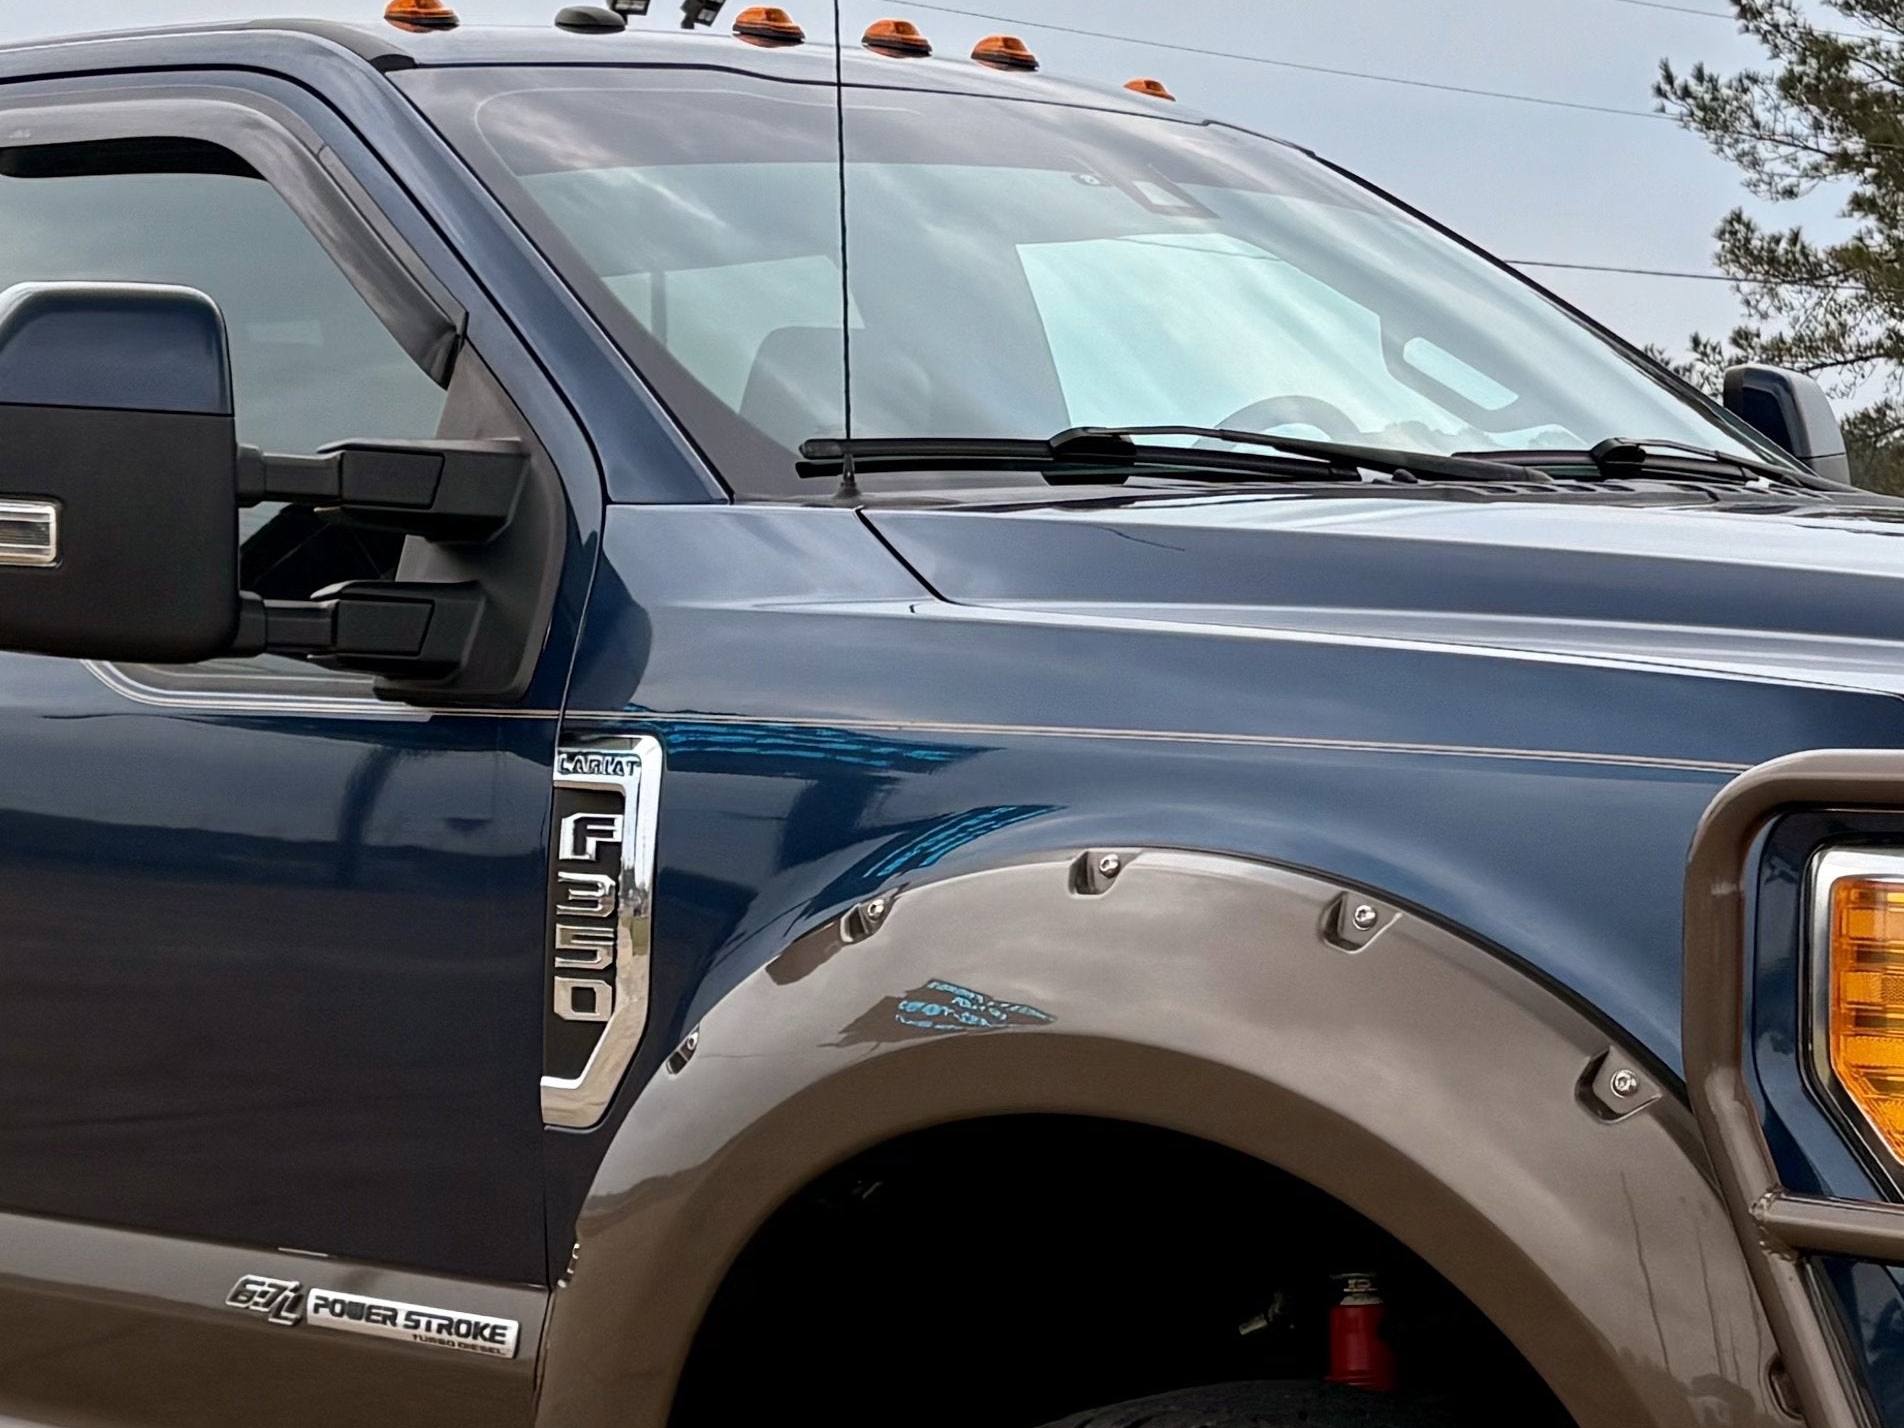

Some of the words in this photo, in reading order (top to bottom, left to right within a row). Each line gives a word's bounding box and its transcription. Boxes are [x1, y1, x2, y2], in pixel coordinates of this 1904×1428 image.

[557, 753, 642, 777] LARIAT
[553, 812, 624, 1022] F350
[312, 1294, 399, 1328] POWER
[403, 1309, 509, 1346] STROKE
[412, 1333, 455, 1348] TURBO
[458, 1341, 507, 1356] DIESEL
